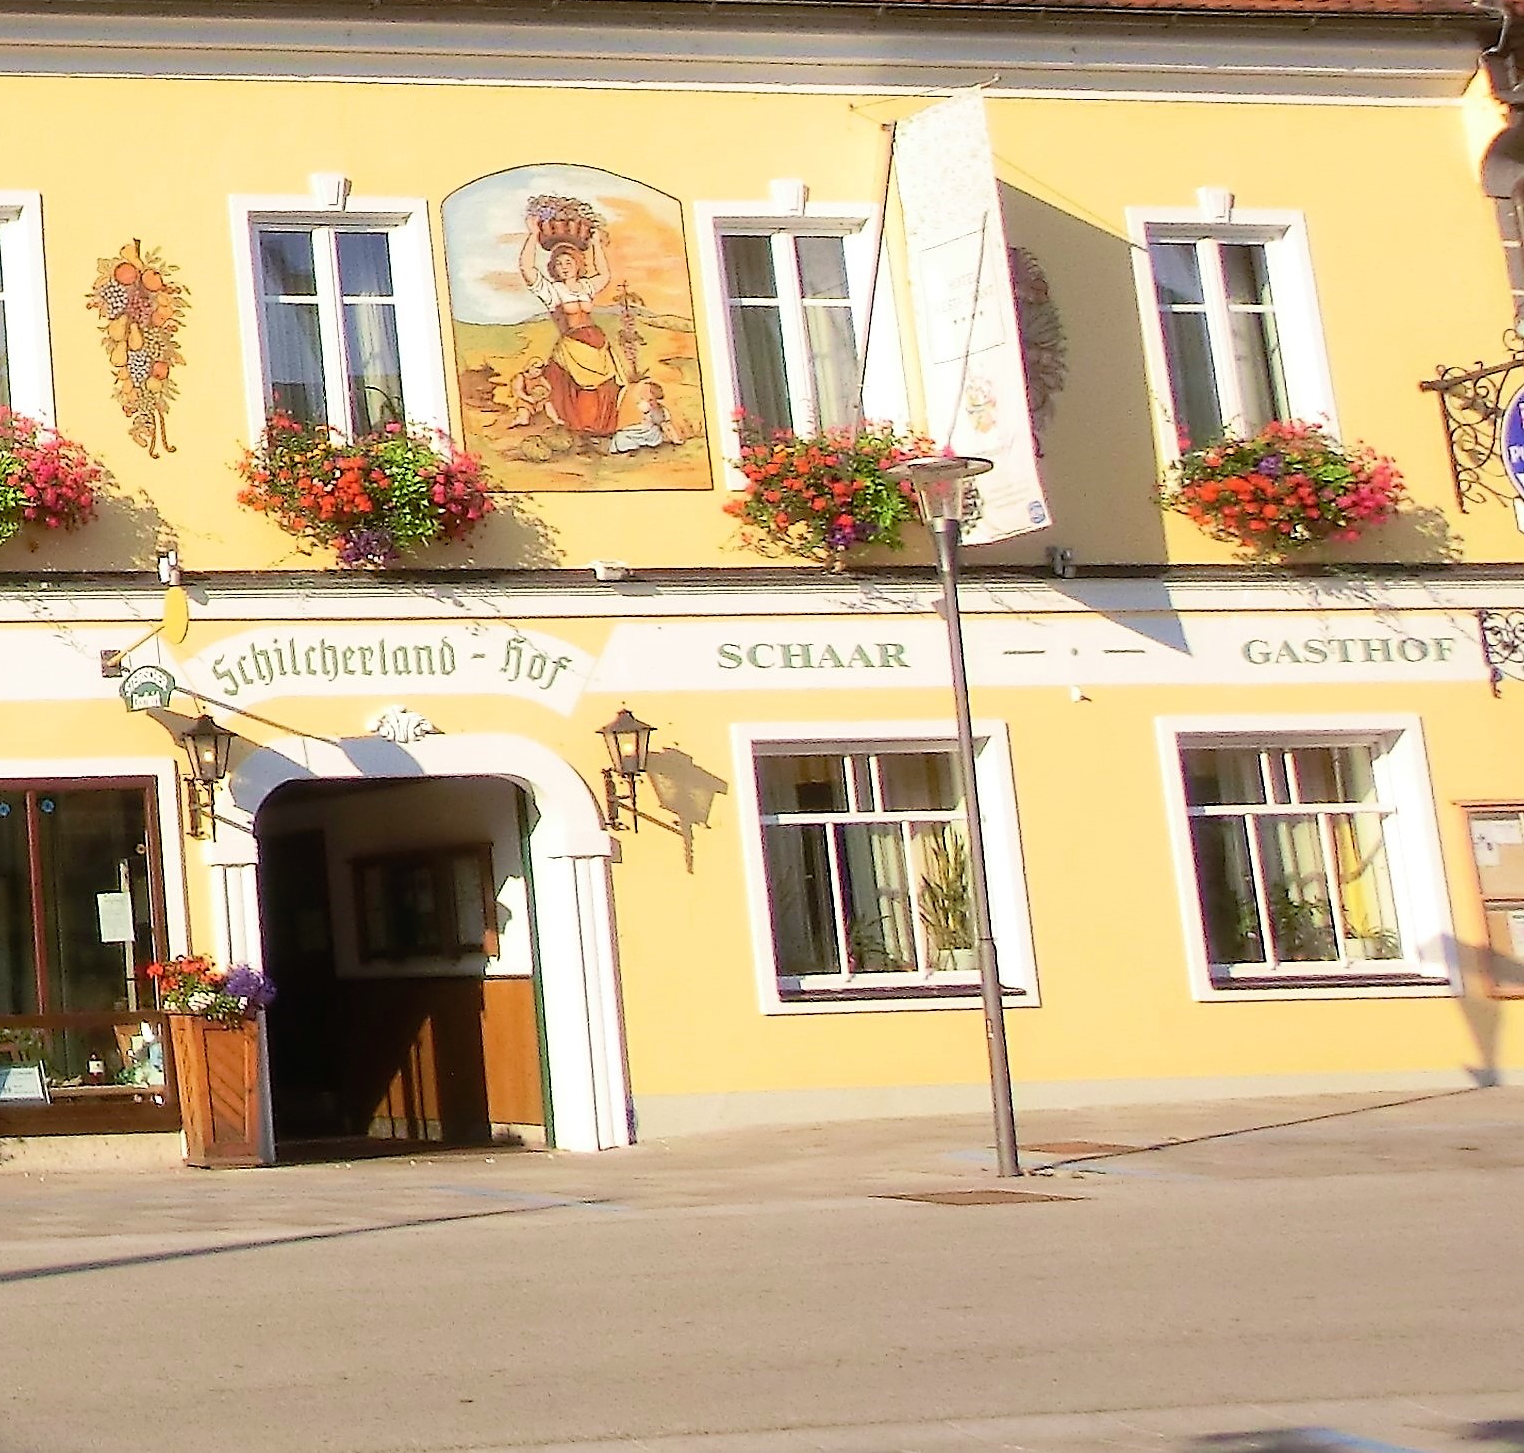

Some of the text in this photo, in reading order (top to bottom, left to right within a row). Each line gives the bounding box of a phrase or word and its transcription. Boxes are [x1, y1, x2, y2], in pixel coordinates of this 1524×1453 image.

[211, 637, 457, 697] Schilcherland
[500, 637, 573, 691] Hof
[716, 637, 1455, 669] SCHAAR GASTHOF
